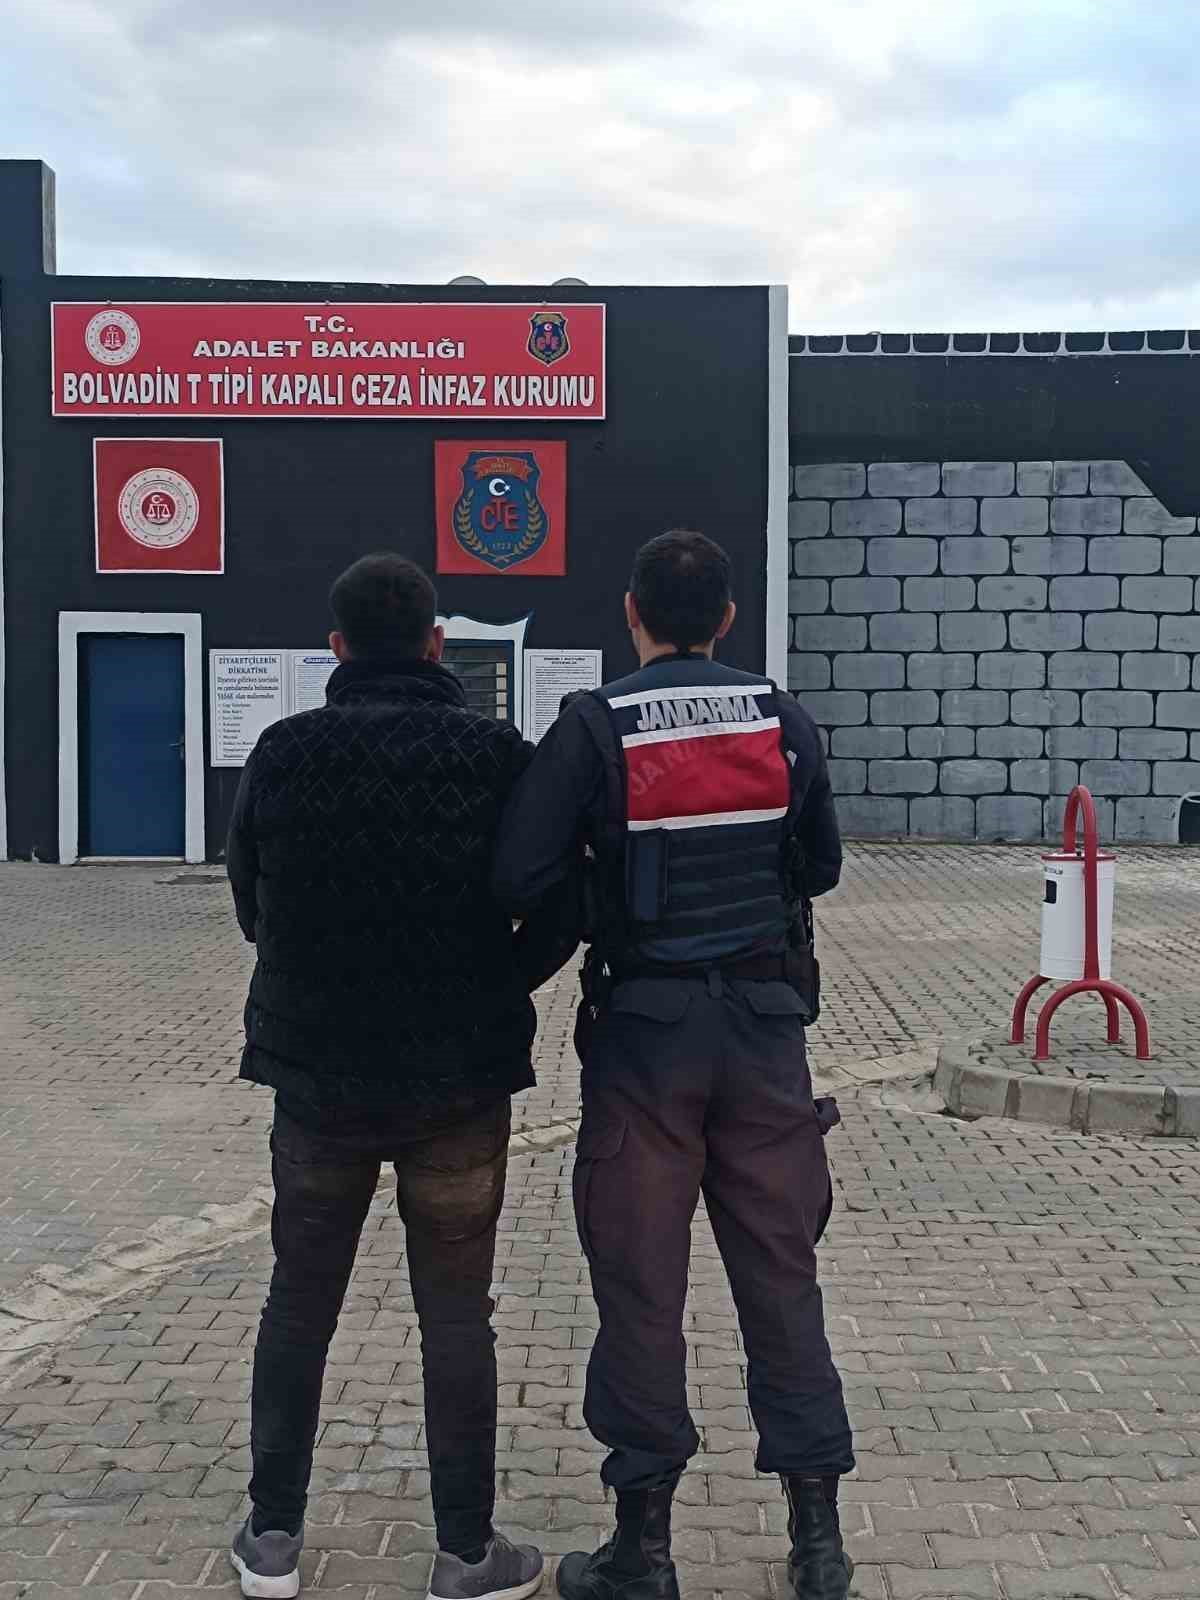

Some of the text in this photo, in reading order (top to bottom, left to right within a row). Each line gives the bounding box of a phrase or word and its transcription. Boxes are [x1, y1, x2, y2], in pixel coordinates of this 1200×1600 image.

[303, 315, 354, 333] T.C.
[193, 337, 465, 359] ADALET BAKANLIĞI
[63, 366, 595, 407] BOLVADİN T TİPİ KAPALI CEZA İNFAZ KURUMU
[637, 695, 763, 731] JANDARMA
